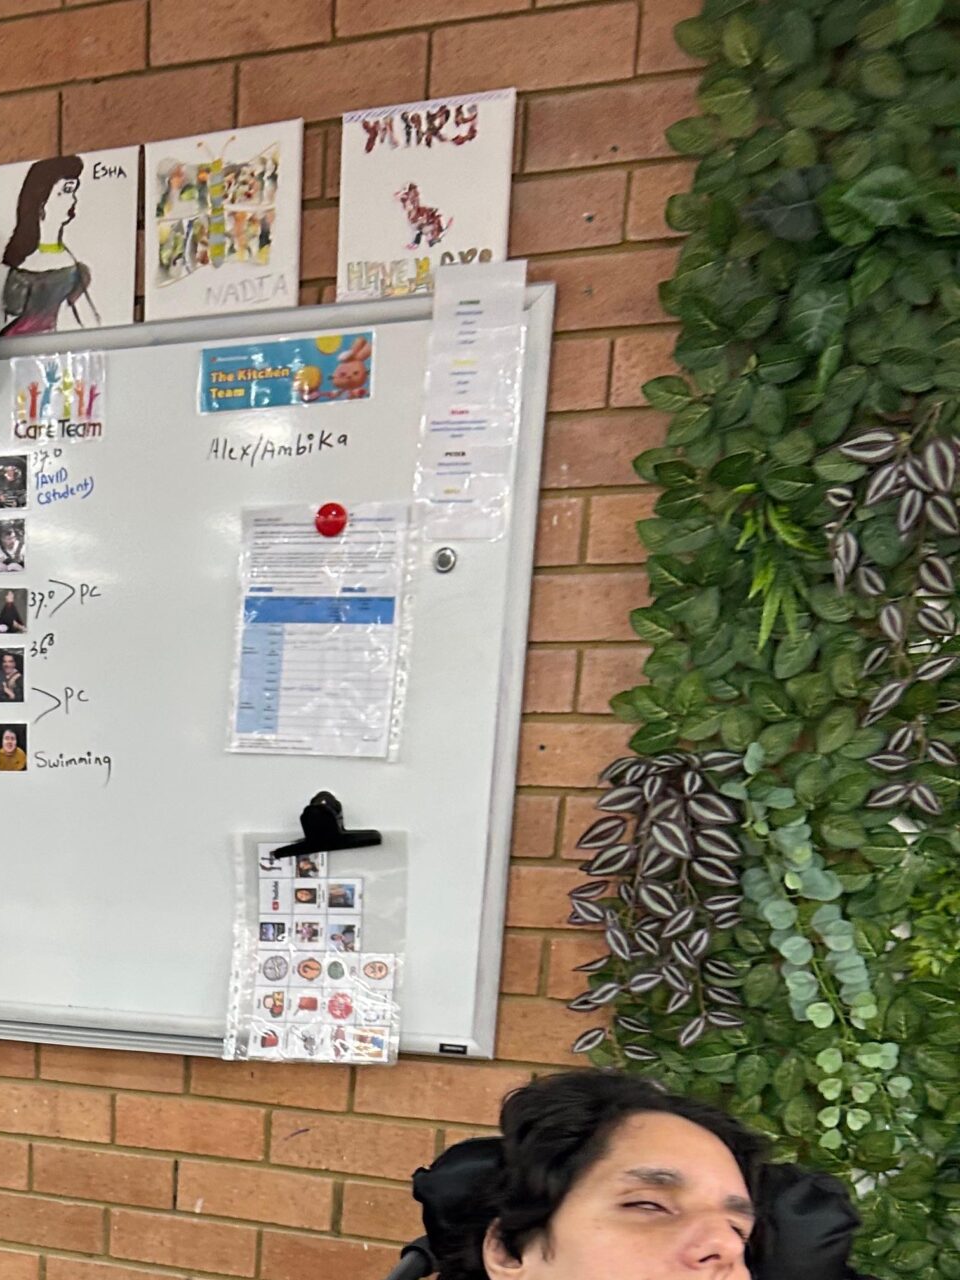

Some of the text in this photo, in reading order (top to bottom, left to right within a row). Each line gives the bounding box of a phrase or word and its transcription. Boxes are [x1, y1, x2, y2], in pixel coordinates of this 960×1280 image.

[93, 161, 127, 180] ESHA
[210, 367, 290, 384] The Kitchen
[210, 387, 246, 399] Team
[57, 418, 102, 439] Team
[34, 750, 112, 787] Swimming
